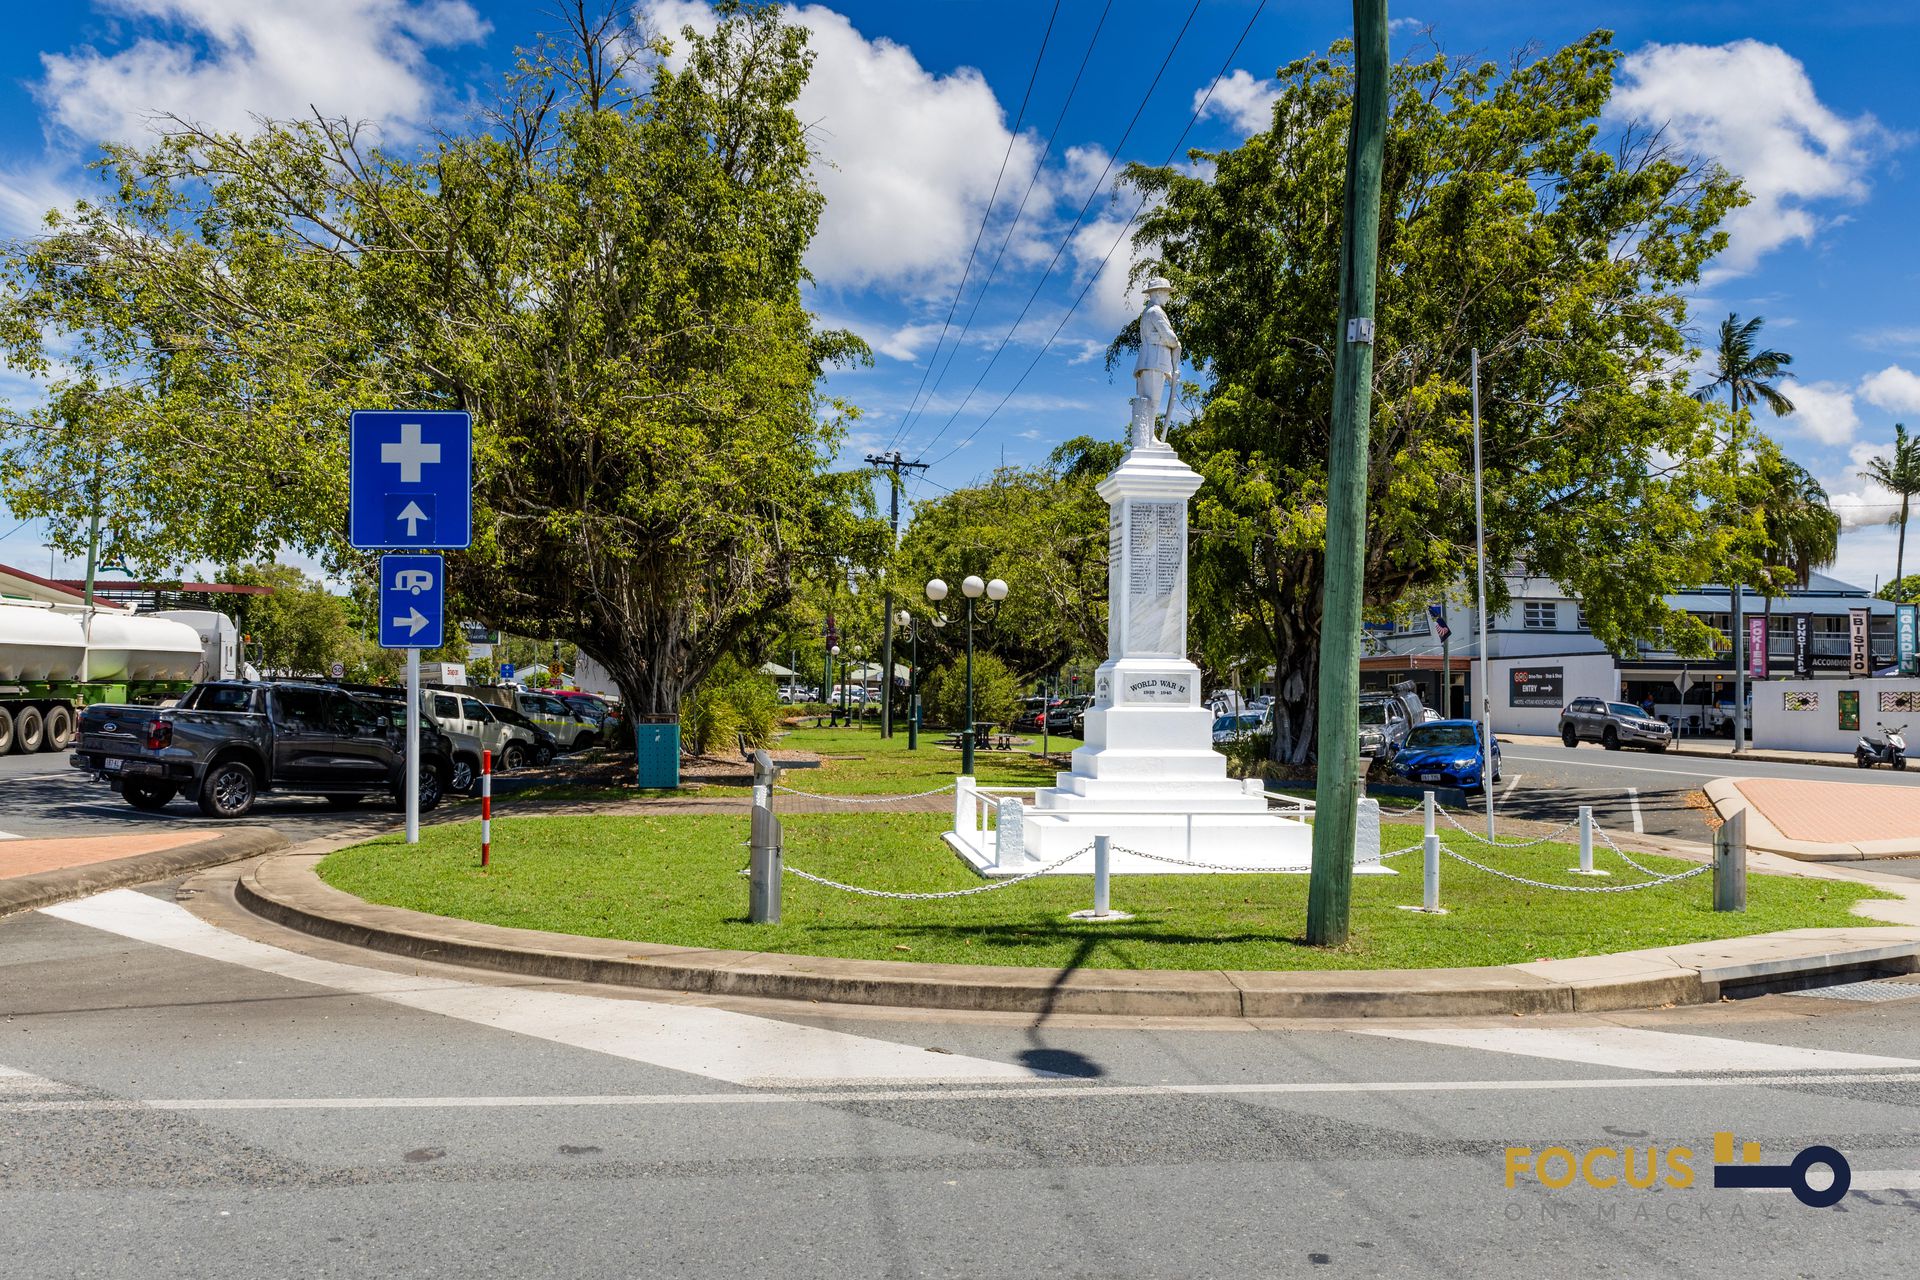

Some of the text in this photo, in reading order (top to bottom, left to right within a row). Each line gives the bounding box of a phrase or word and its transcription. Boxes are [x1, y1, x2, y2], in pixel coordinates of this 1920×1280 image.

[1752, 620, 1763, 666] POKIES
[1797, 618, 1807, 673] FUNCTIONS
[1853, 618, 1864, 670] BISTRO
[1900, 615, 1913, 670] GARDEN
[1130, 680, 1157, 691] WORLD
[1160, 680, 1177, 689] WAR
